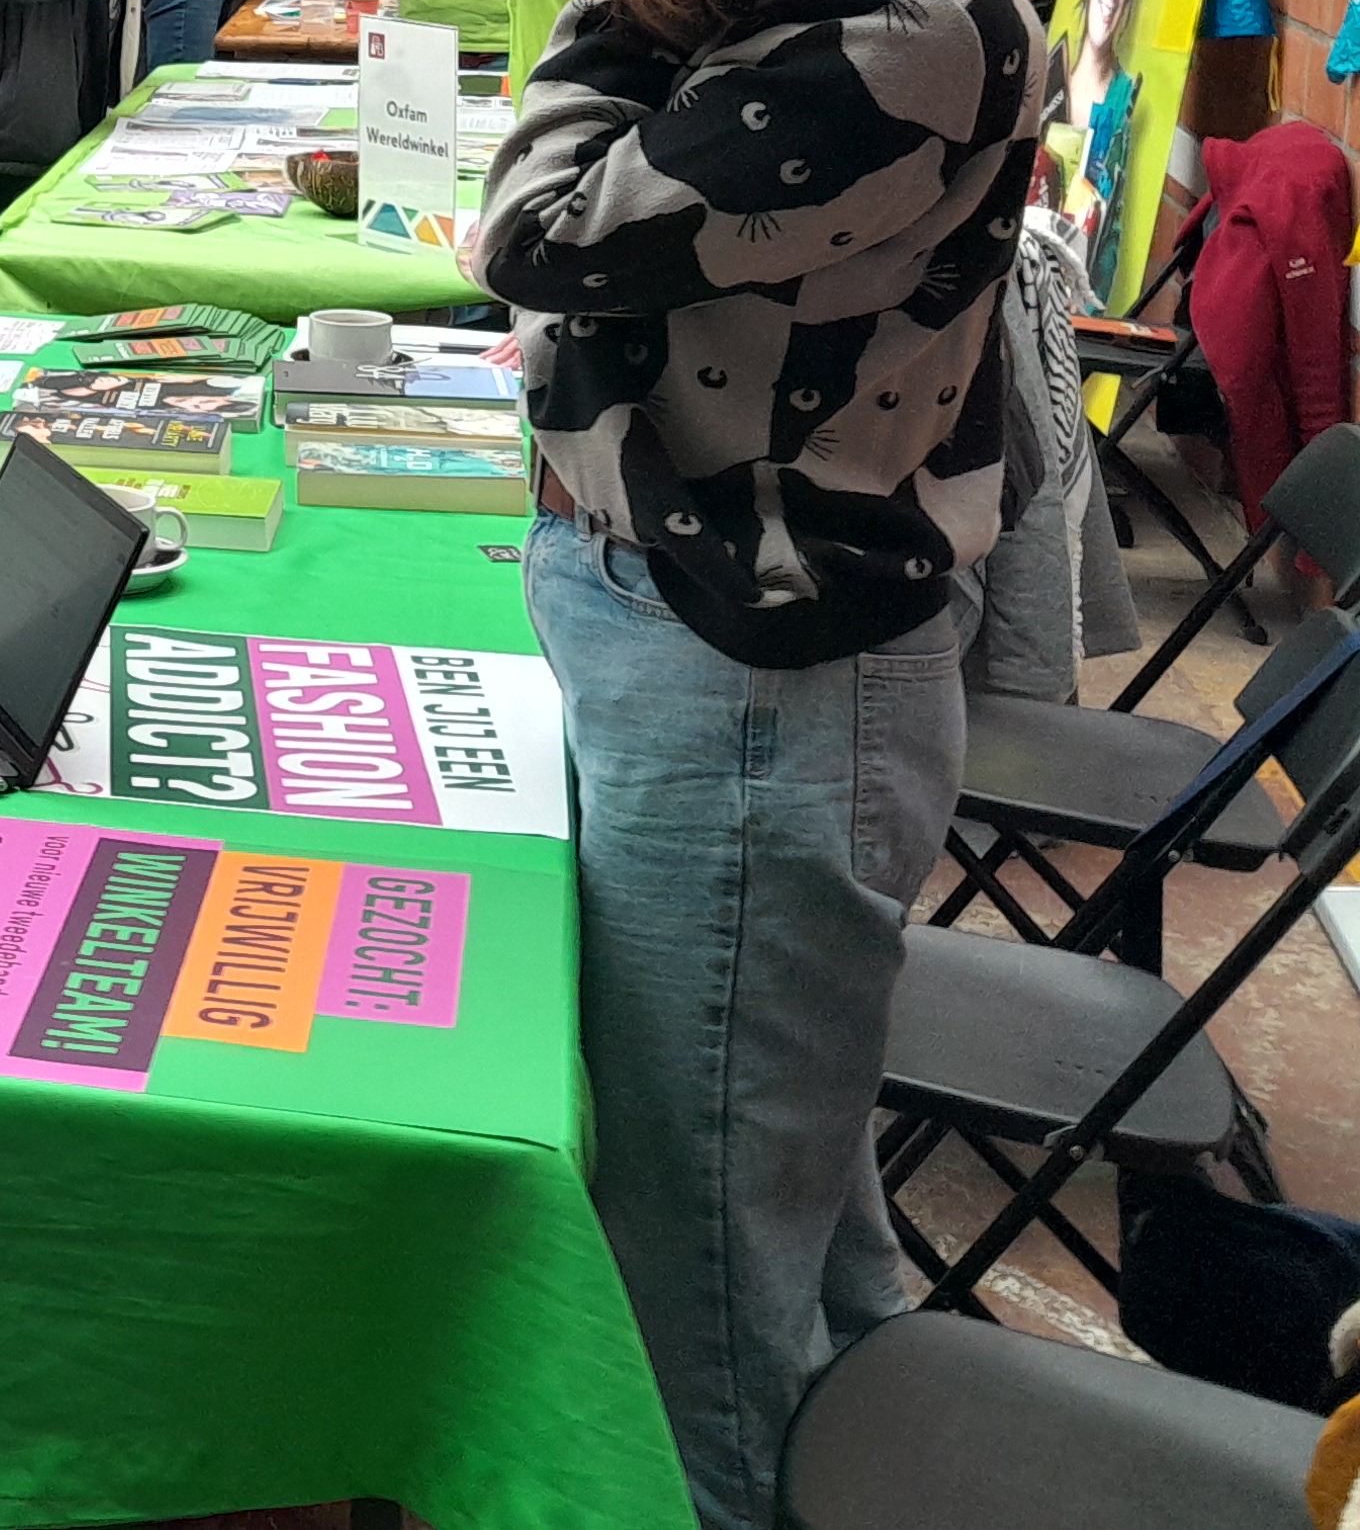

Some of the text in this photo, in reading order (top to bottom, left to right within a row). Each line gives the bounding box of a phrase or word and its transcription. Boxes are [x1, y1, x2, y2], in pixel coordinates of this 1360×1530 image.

[366, 125, 450, 158] Wereldwinkel
[386, 100, 429, 124] Oxfam
[124, 632, 258, 803] ADDICT?
[258, 642, 415, 810] FASHION
[410, 654, 517, 794] BEN JIJ EEN
[16, 862, 62, 908] nieuwe
[37, 835, 70, 862] voor
[39, 851, 188, 1056] WINKELTEAM!
[198, 865, 311, 1030] VRIJWILLIG
[345, 875, 437, 1012] GEZOCHT:
